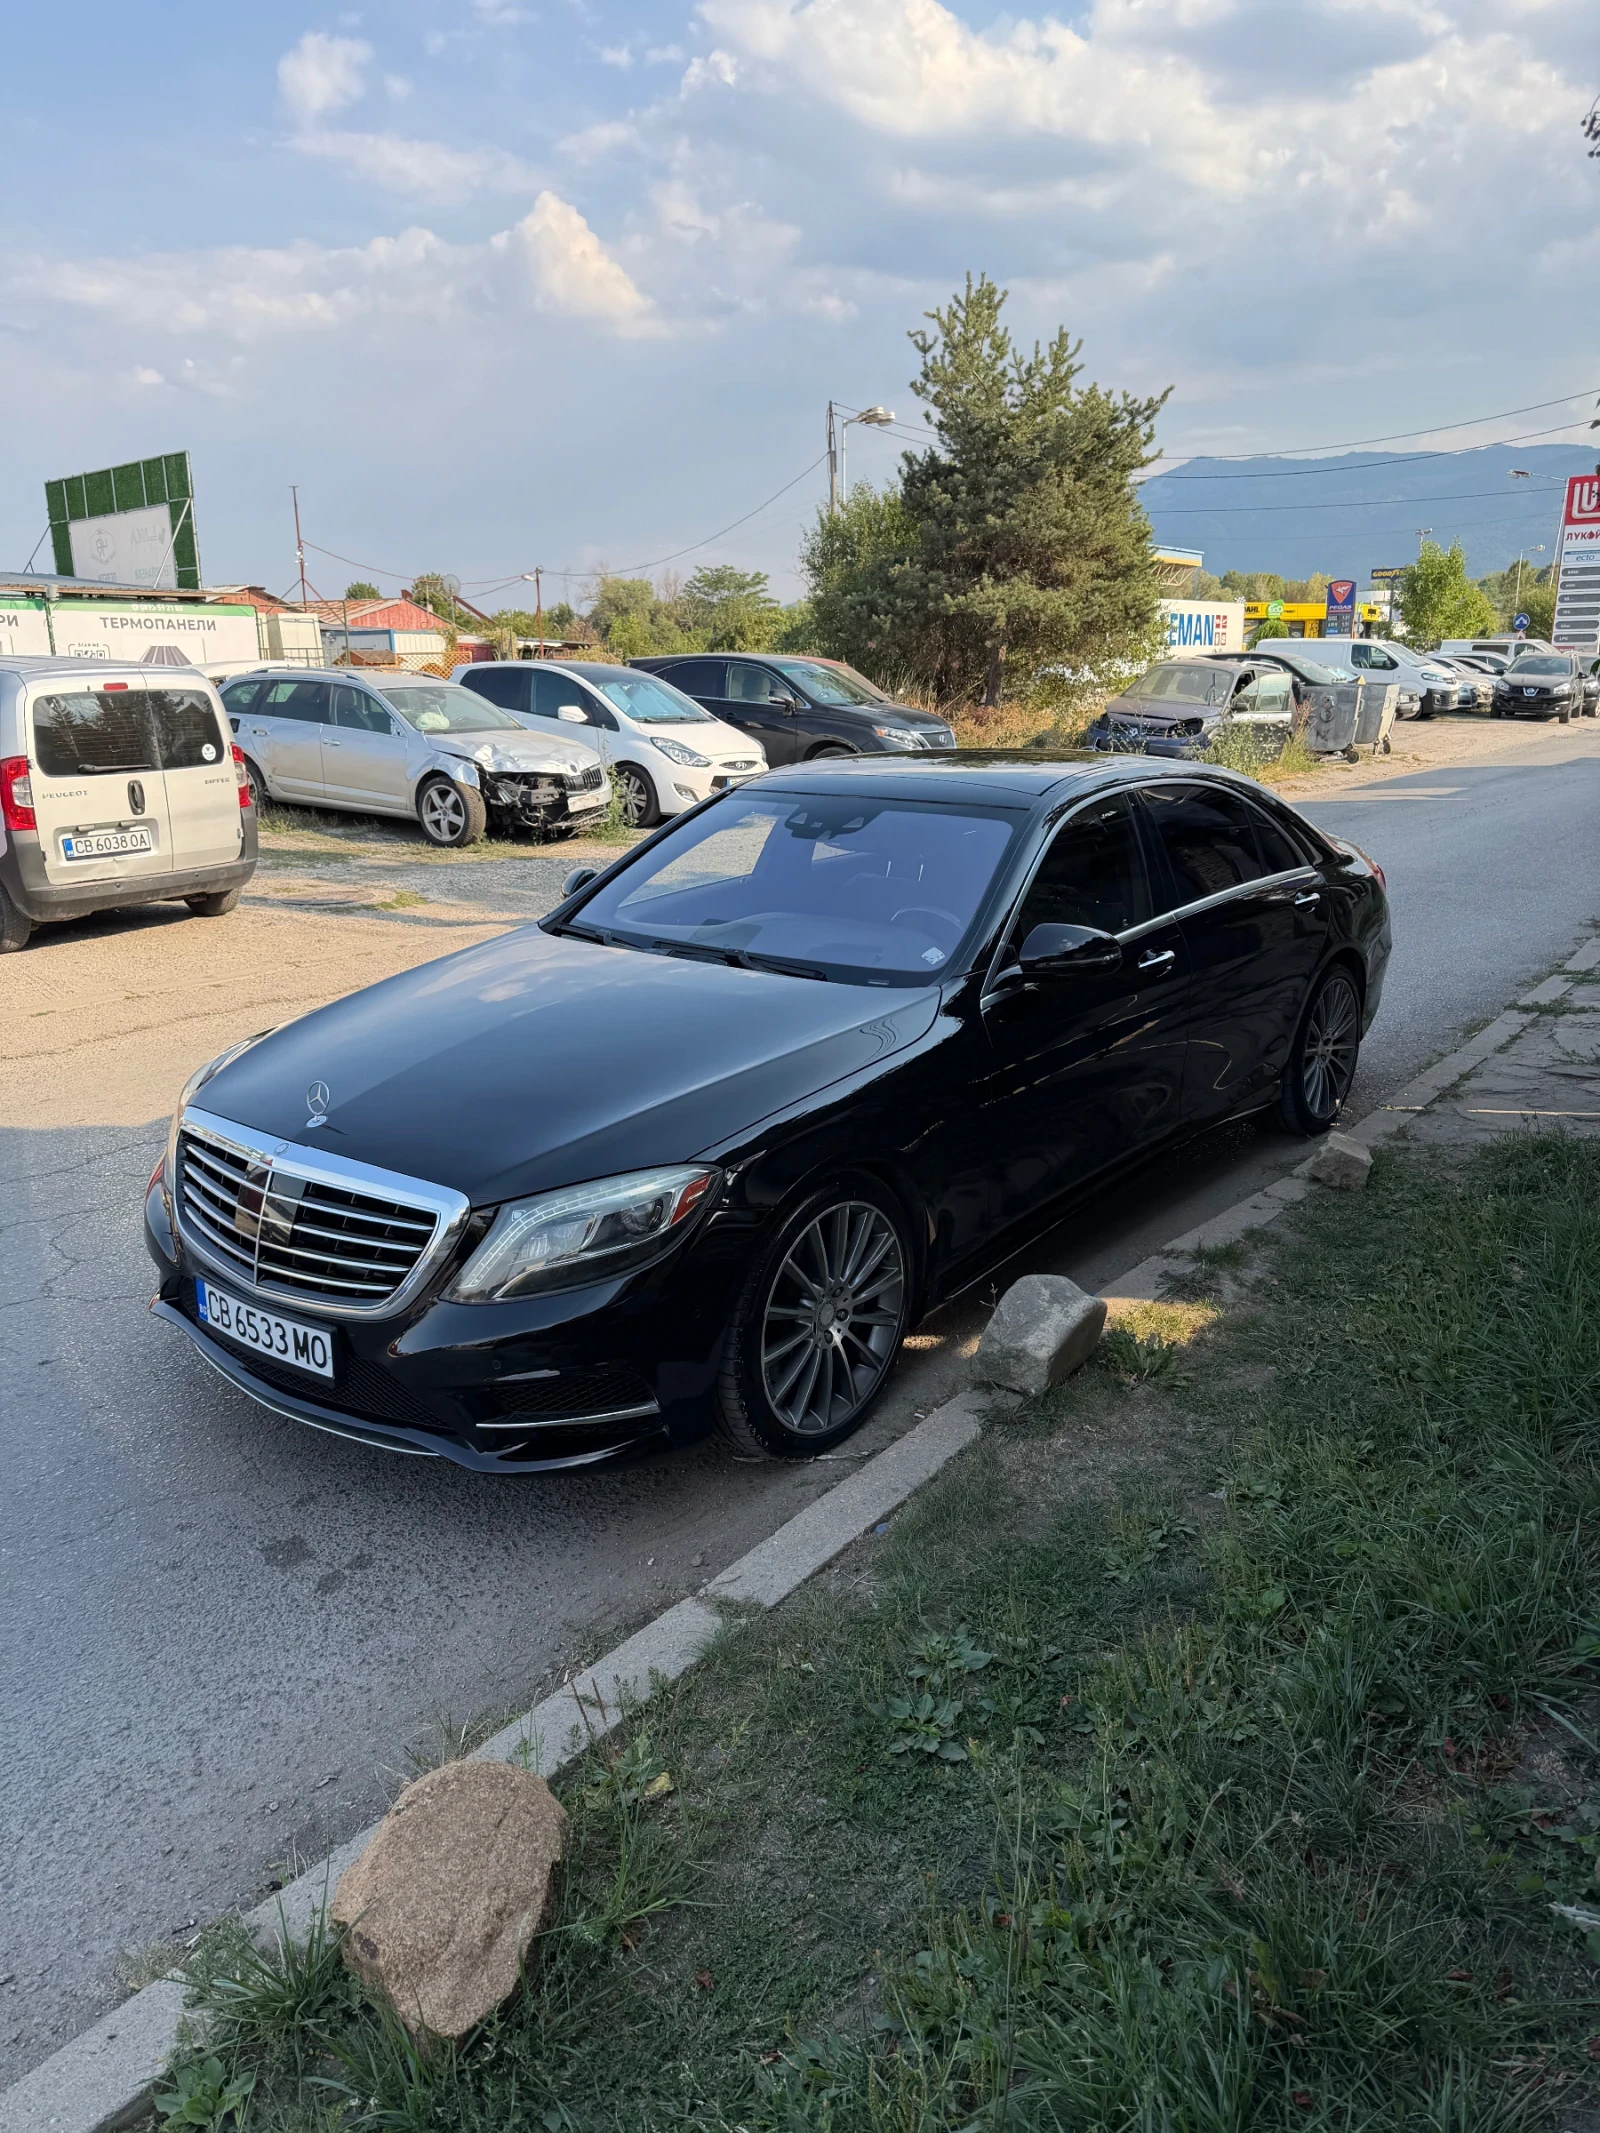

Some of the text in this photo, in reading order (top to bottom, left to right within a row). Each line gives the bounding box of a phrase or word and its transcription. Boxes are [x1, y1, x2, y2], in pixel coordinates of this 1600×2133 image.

[99, 617, 217, 631] ТЕРМОПАНЕЛИ
[42, 790, 88, 799] PEUGEOT
[75, 833, 148, 854] CB 6038 OA
[207, 1290, 328, 1369] CB 6533 MO
